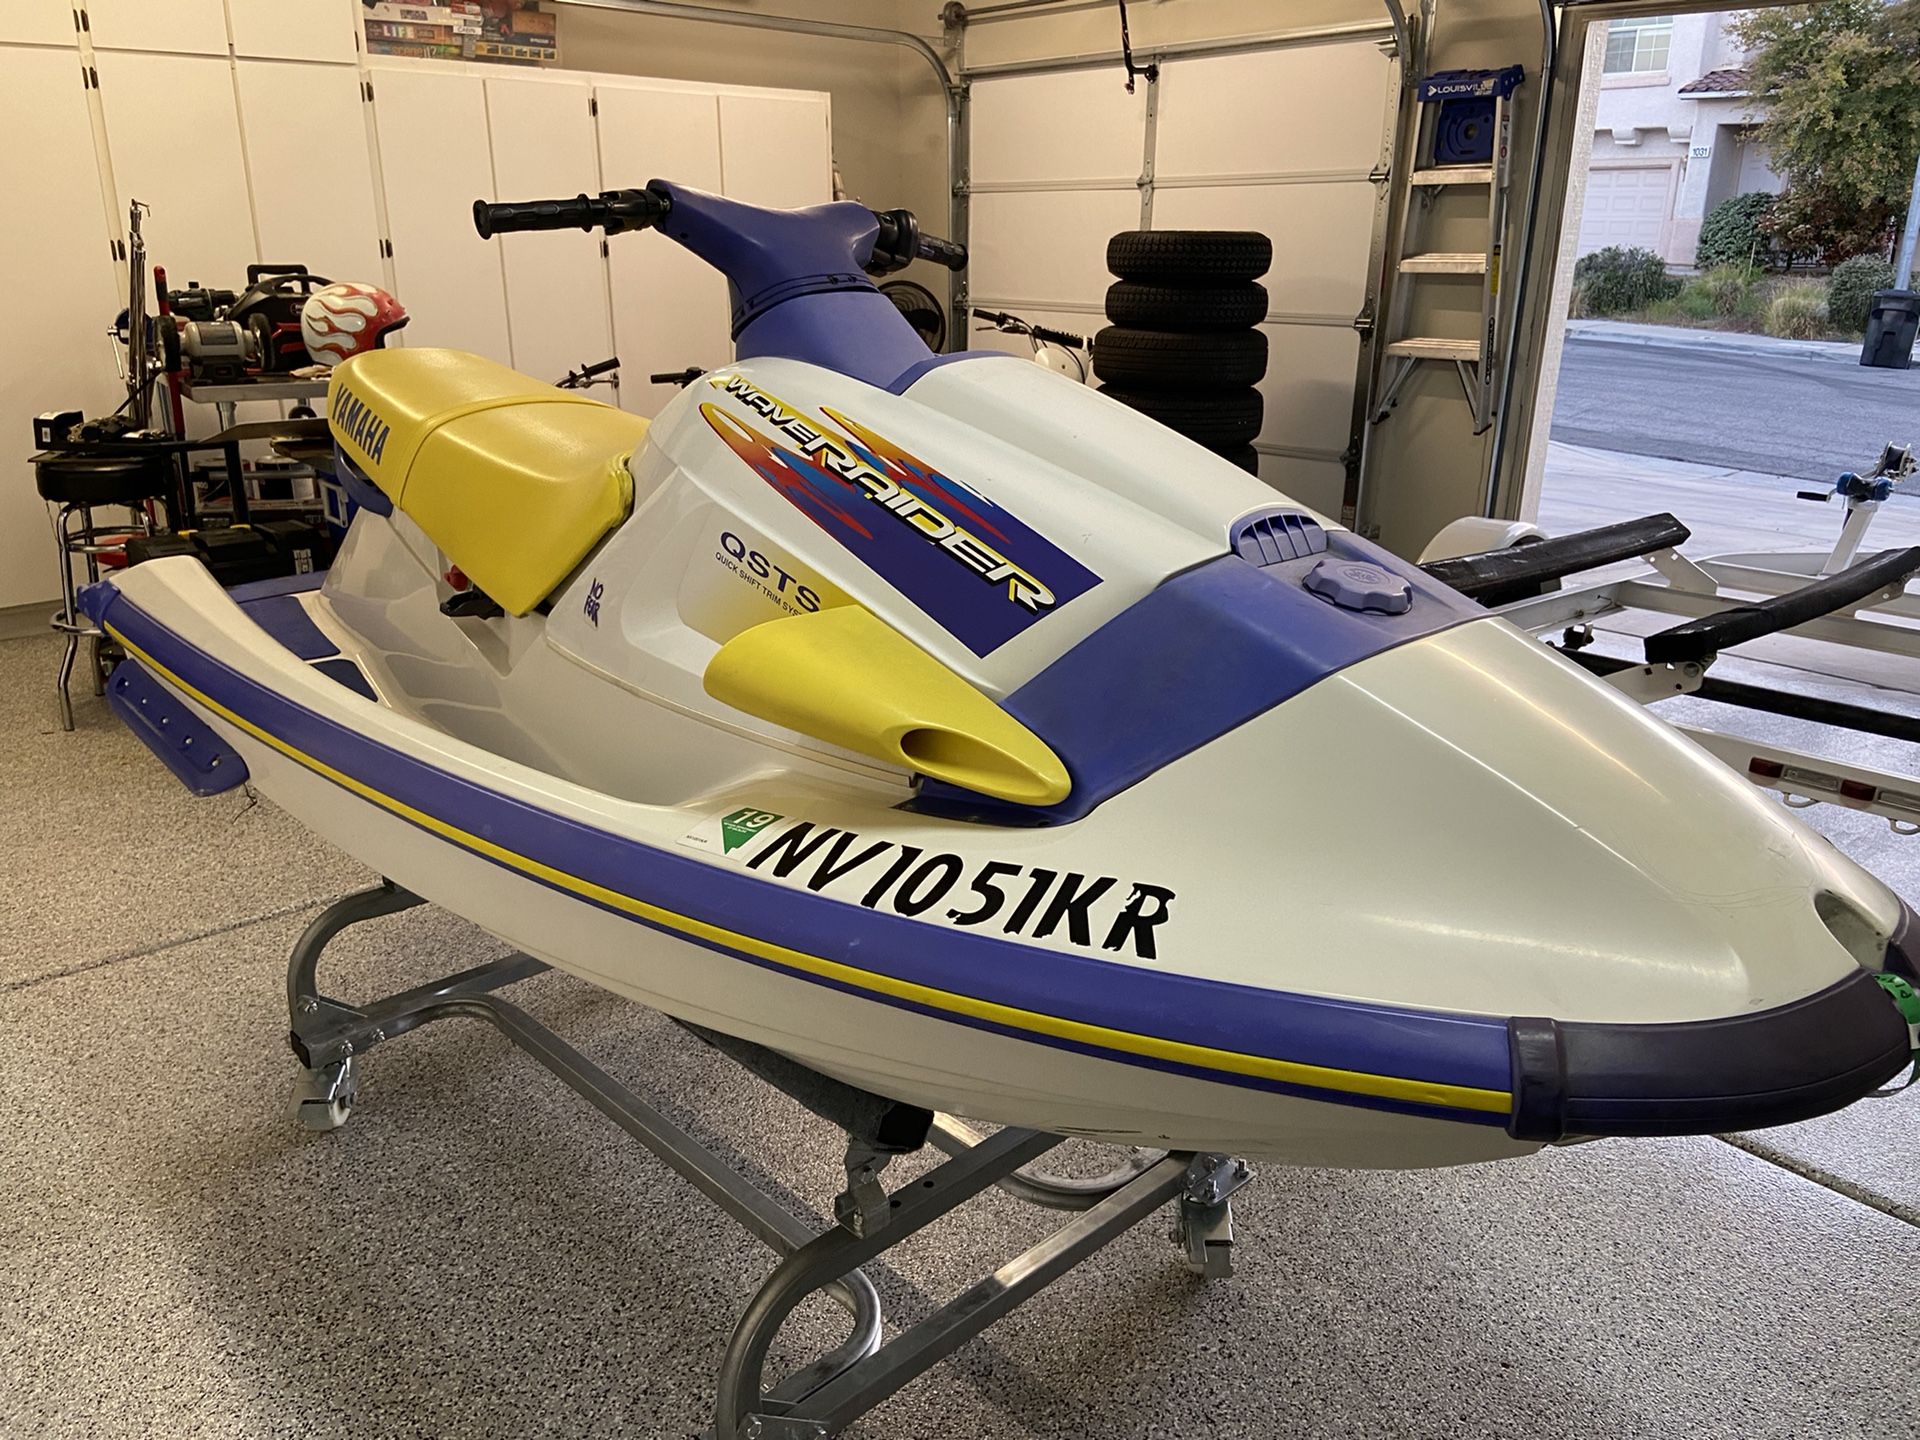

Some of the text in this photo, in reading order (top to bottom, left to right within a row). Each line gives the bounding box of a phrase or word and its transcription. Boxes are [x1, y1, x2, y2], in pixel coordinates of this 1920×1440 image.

[1692, 147, 1708, 157] 1031
[332, 382, 390, 466] YAMAHA
[715, 551, 738, 574] QUICK
[739, 569, 761, 590] SHIFT
[762, 586, 782, 606] TRIM
[719, 530, 821, 613] QSTS
[733, 810, 775, 828] 19
